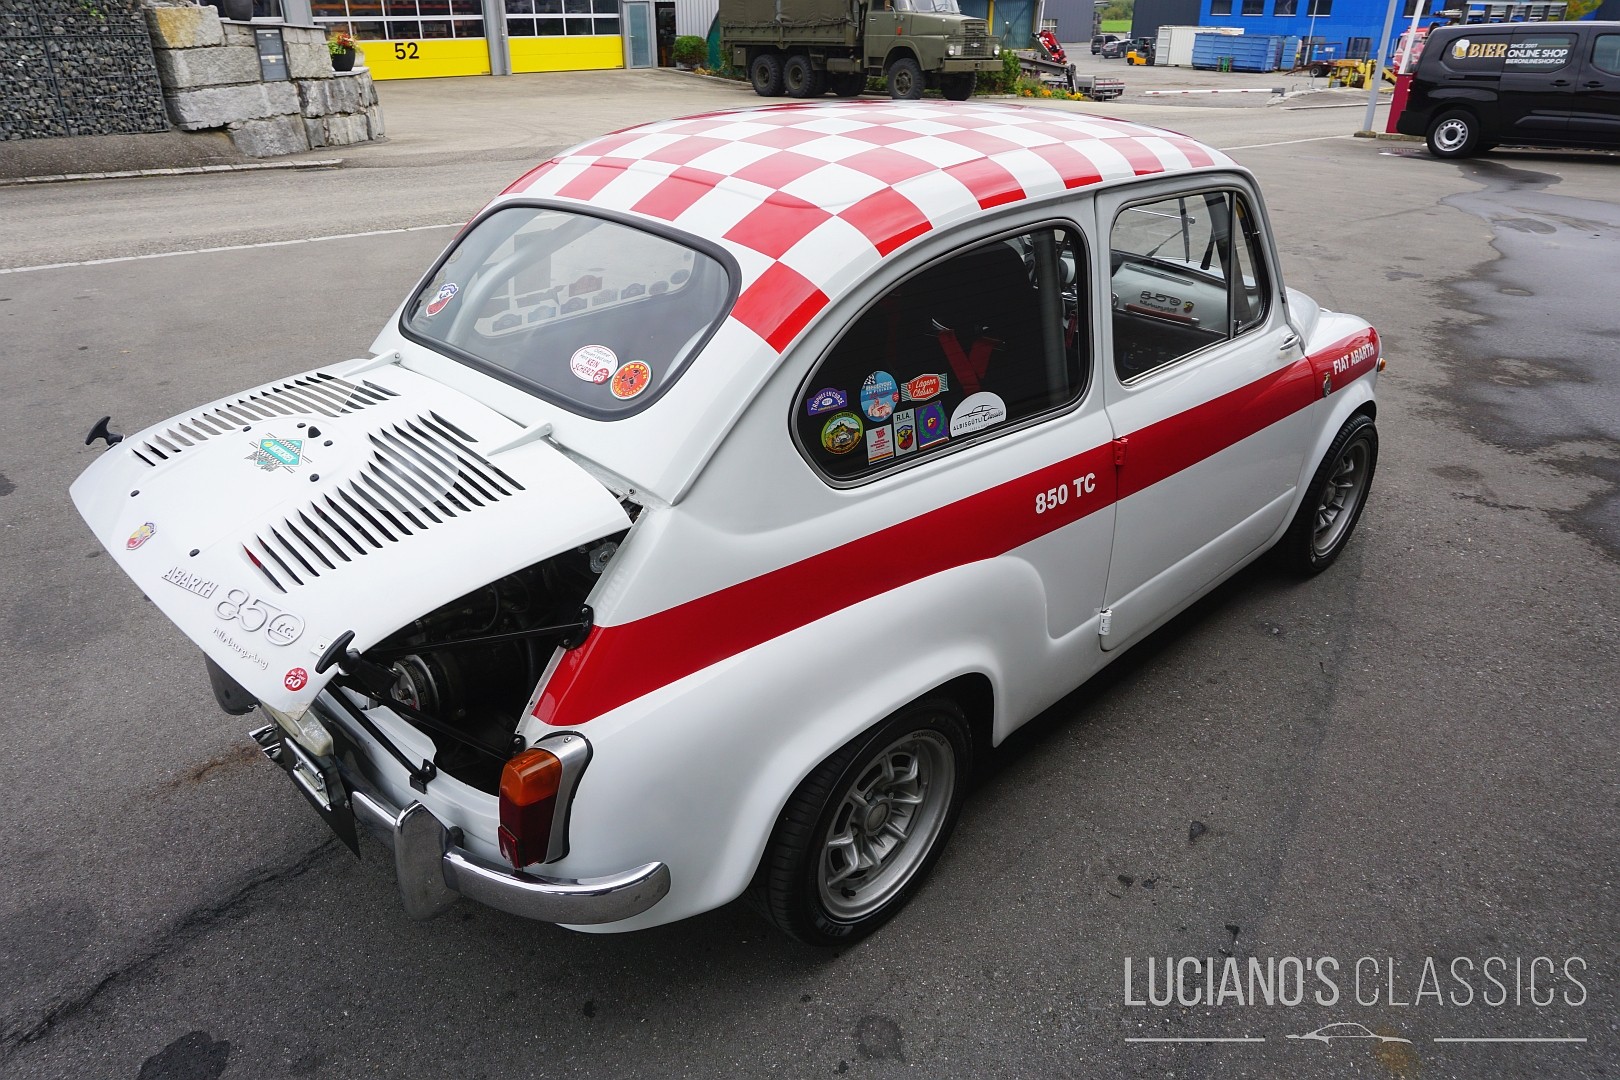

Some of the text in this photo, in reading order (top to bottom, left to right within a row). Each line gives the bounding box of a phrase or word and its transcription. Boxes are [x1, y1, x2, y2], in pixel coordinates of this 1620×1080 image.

[394, 42, 420, 60] 52
[1467, 43, 1508, 58] BIER
[1507, 49, 1568, 58] ONLINE SHOP
[1332, 342, 1375, 375] FIAT ABARTH
[624, 364, 648, 380] ABARTH
[1035, 472, 1096, 514] 850 TC
[161, 567, 219, 599] ABARTH
[215, 588, 306, 648] 850
[285, 675, 302, 688] 60
